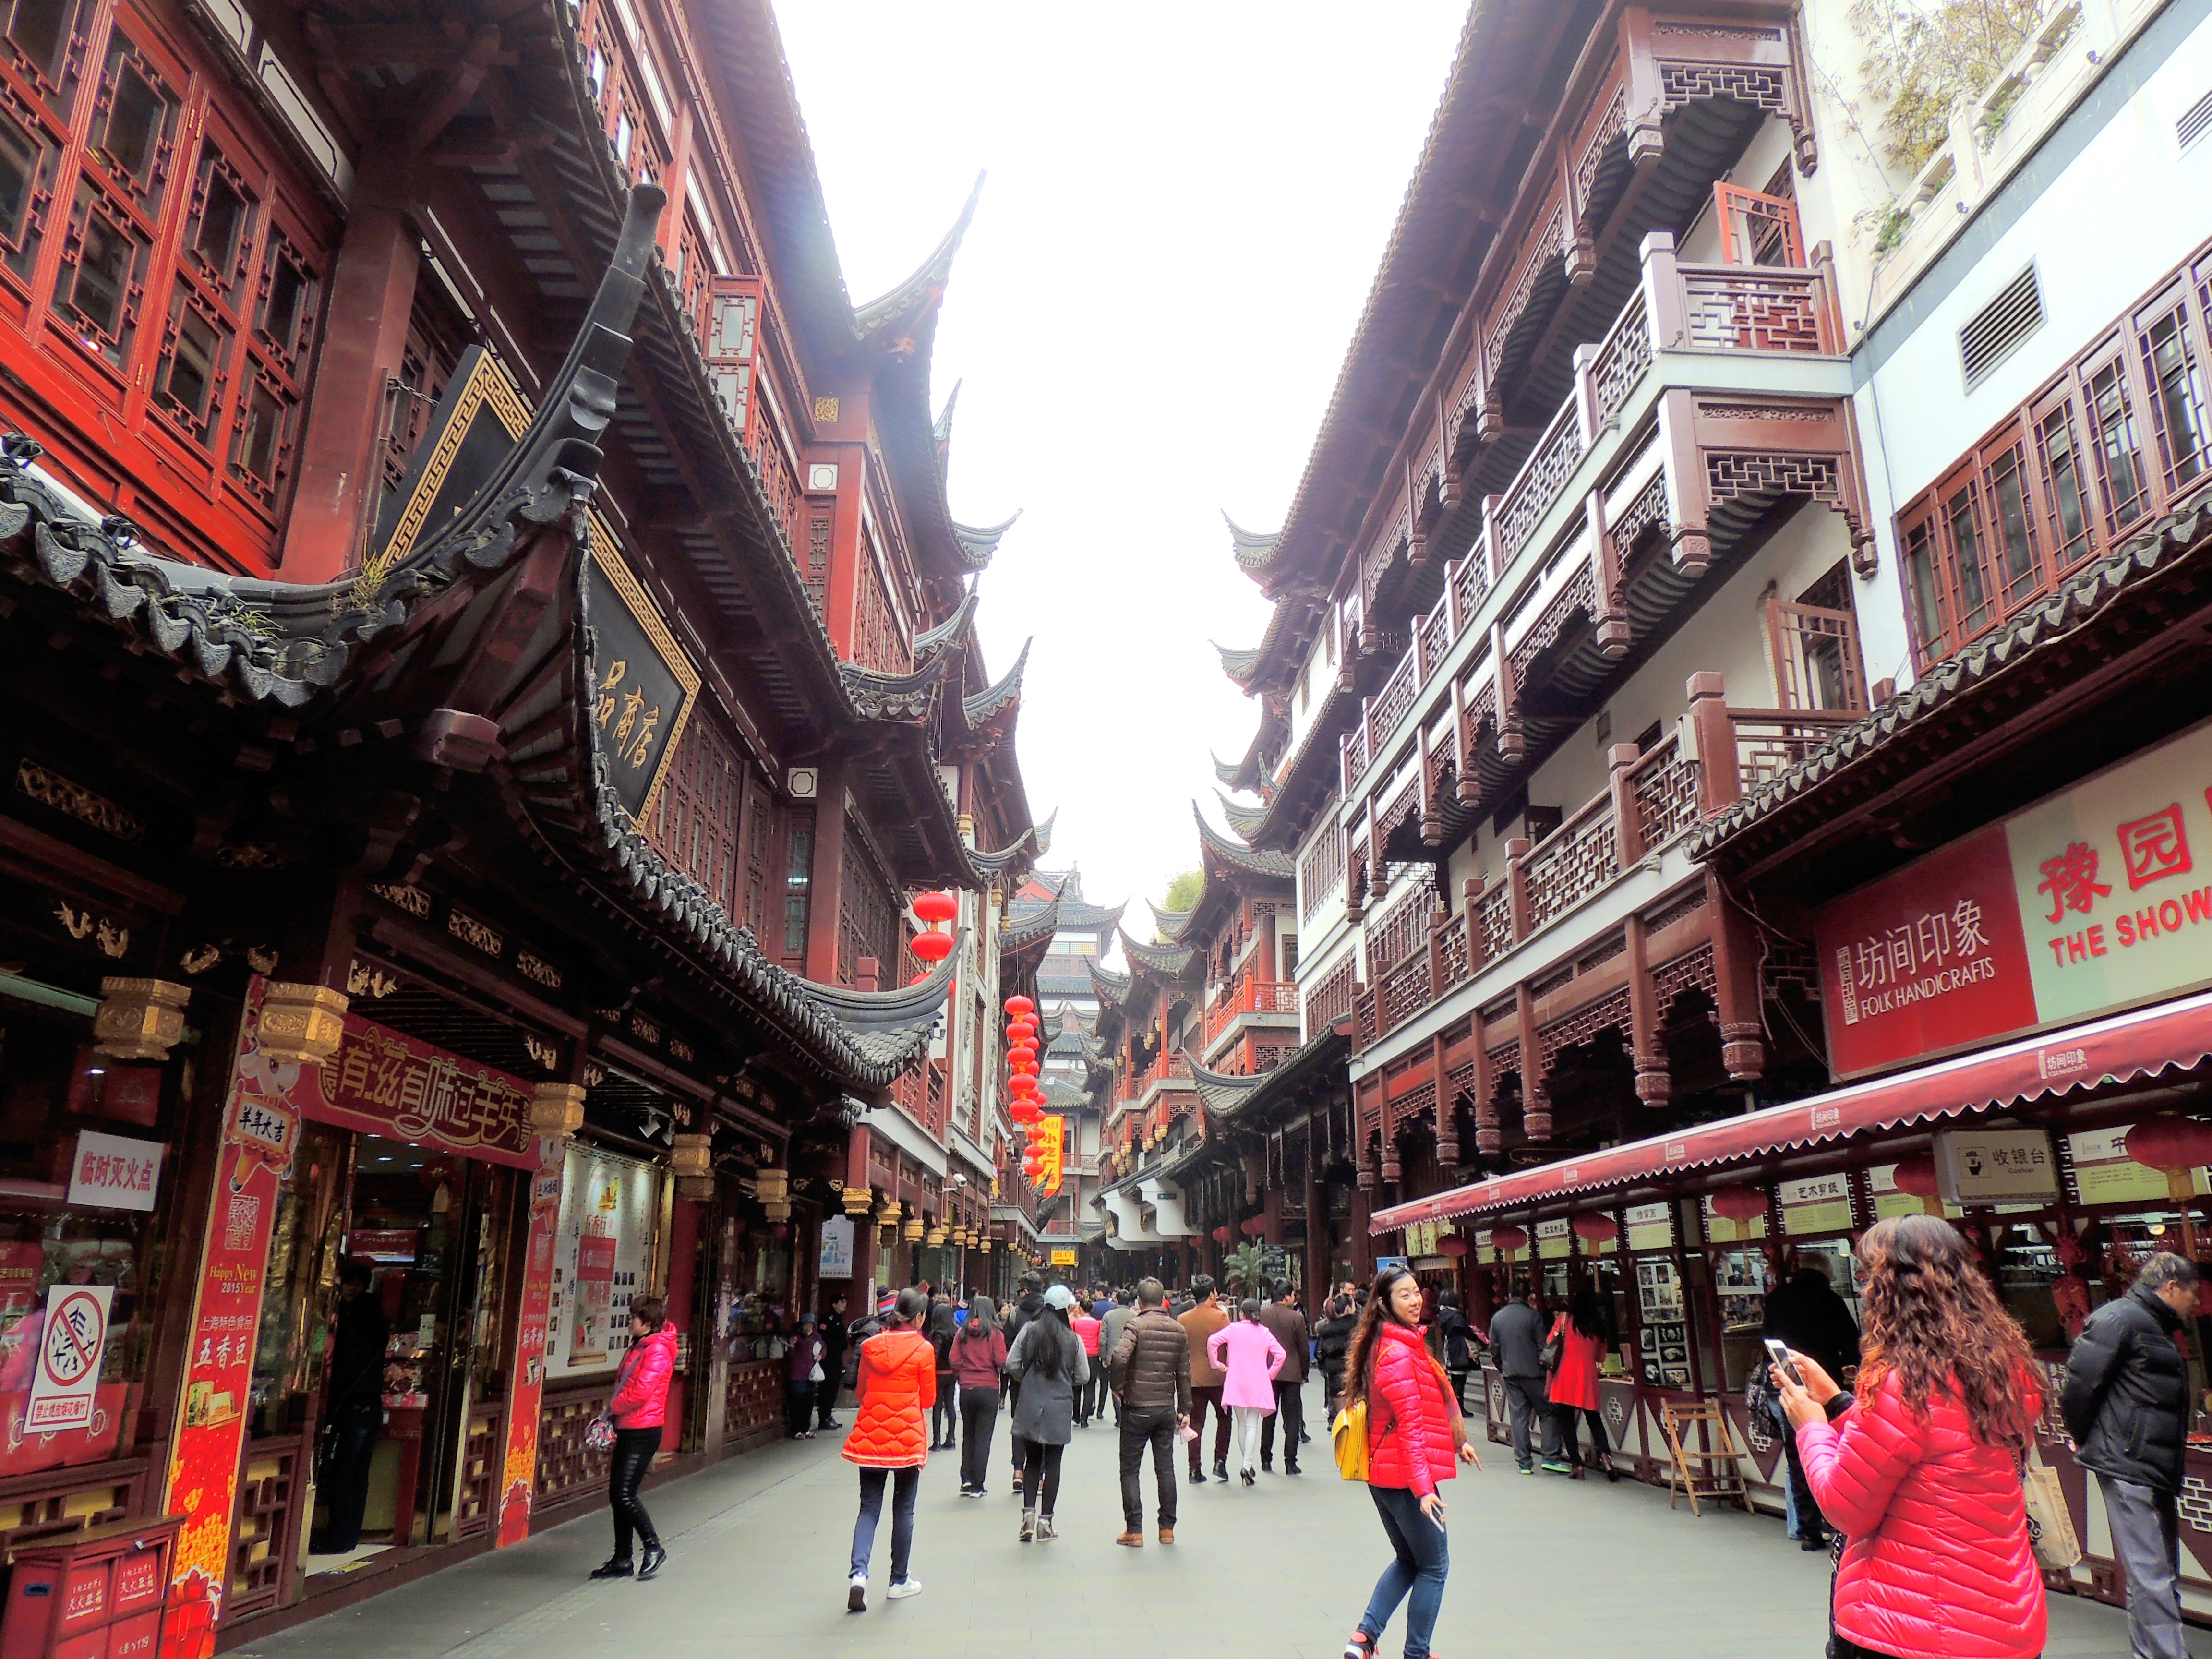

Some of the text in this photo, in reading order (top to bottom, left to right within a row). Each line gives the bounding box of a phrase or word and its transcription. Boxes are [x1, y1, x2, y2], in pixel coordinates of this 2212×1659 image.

[2038, 787, 2212, 924] 豫园
[2048, 886, 2212, 968] THE SHOW
[1857, 899, 1990, 990] 坊间印象
[1861, 993, 1894, 1019] FOLK
[1895, 957, 1995, 1007] HANDICRAFTS
[2047, 1048, 2086, 1070] 坊间印象
[239, 1106, 285, 1143] 羊年大吉
[80, 1151, 154, 1191] 临时灭火点
[1993, 1148, 2044, 1166] 收银台
[210, 1263, 257, 1281] Happy New
[221, 1282, 256, 1294] 2015 Year
[199, 1315, 254, 1331] 上海特色食品
[193, 1333, 247, 1370] 五香豆
[35, 1400, 86, 1419] 禁止燃放烟花爆竹
[137, 1635, 149, 1650] 119
